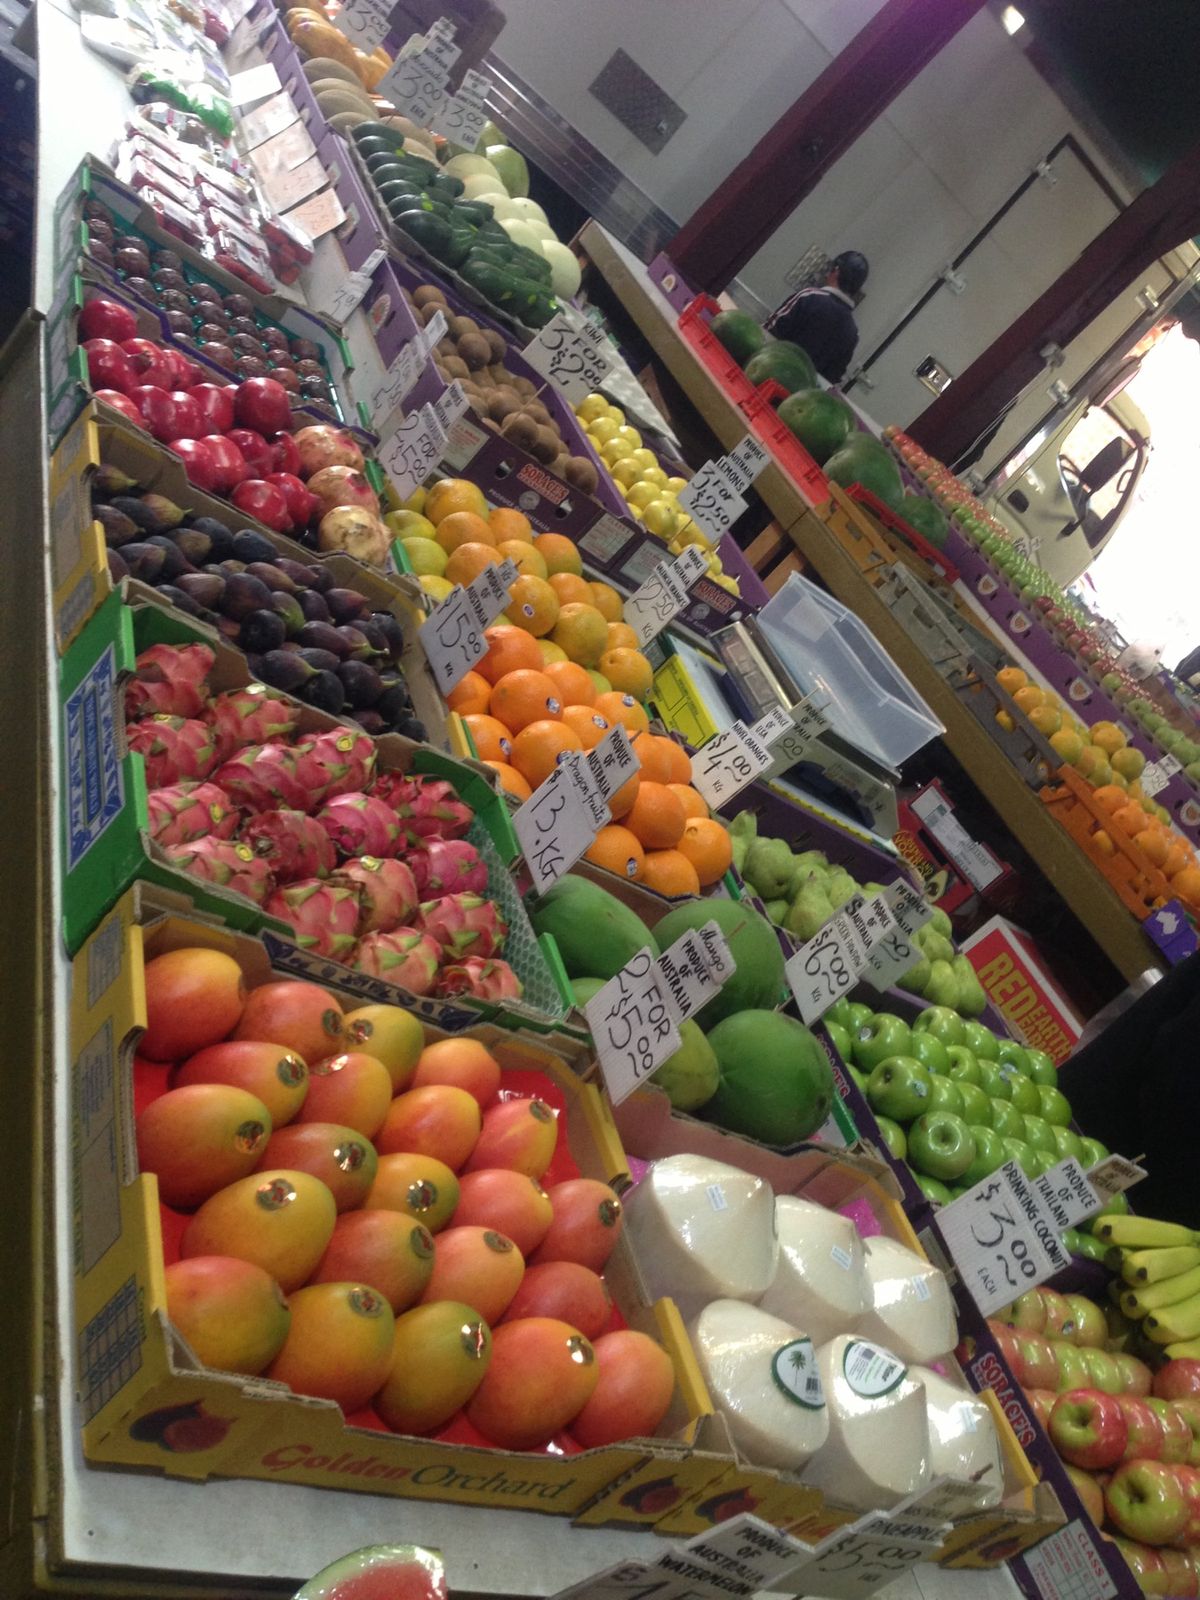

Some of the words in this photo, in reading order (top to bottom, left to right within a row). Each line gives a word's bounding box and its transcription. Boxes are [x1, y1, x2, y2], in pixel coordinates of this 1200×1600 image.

[582, 323, 606, 344] KIWI
[394, 413, 421, 444] 2
[416, 433, 437, 463] FOR
[744, 438, 766, 461] PRODUCE
[717, 459, 745, 492] LEMONS
[730, 452, 755, 480] AUSTRALIA
[480, 587, 492, 599] OF
[485, 567, 505, 601] PRODUCE
[670, 585, 687, 608] ORANGES
[466, 586, 489, 627] AUSTRALIA
[609, 730, 632, 768] PRODUCE
[732, 722, 747, 741] NAVEL
[745, 738, 769, 766] ORANGES
[755, 725, 769, 739] USA
[568, 755, 590, 797] Dragon
[603, 753, 616, 768] OF
[852, 913, 873, 949] AUSTRALIA
[866, 917, 877, 928] OF
[871, 899, 892, 928] PRODUCE
[682, 939, 711, 986] PRODUCE
[700, 928, 725, 972] Mango
[678, 964, 693, 979] OF
[977, 952, 1037, 1022] RED
[616, 954, 651, 994] 2
[642, 985, 671, 1044] FOR
[1028, 1004, 1072, 1058] EARTH
[1035, 1175, 1070, 1227] THAILAND
[1058, 1187, 1073, 1203] OF
[1062, 1163, 1097, 1210] PRODUCE
[1002, 1160, 1040, 1221] DRINKING
[1034, 1218, 1069, 1271] COCONUT
[977, 1266, 998, 1296] EACH
[261, 1443, 412, 1481] Golden
[411, 1464, 577, 1499] Orchard
[734, 1527, 798, 1559] PRODUCE
[868, 1519, 946, 1543] PINEAPPLE
[689, 1544, 764, 1584] AUSTRALIA
[737, 1546, 762, 1559] OF
[1078, 1533, 1104, 1577] CLASS
[657, 1554, 753, 1596] WATERMELON
